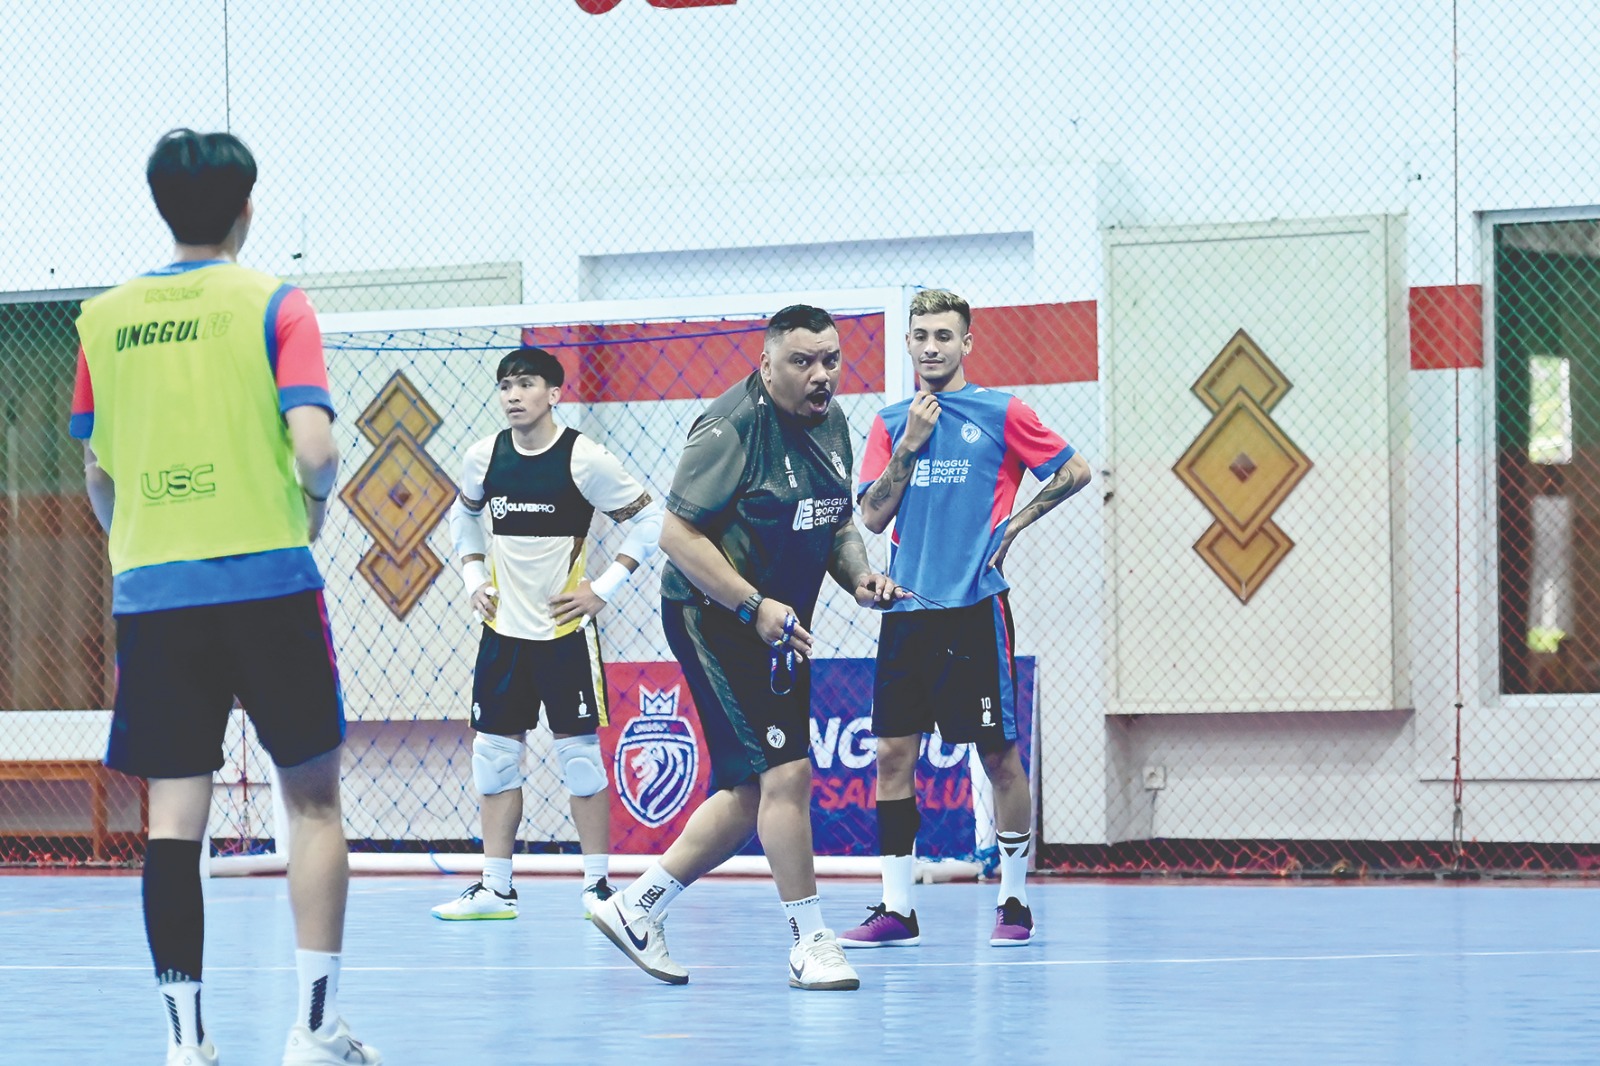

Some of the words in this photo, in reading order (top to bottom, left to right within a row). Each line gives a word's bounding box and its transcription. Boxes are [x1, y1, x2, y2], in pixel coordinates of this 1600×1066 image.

[116, 318, 200, 352] UNGGUL
[141, 463, 216, 500] USC
[507, 503, 555, 513] OLIVERPRO
[980, 696, 992, 710] 10
